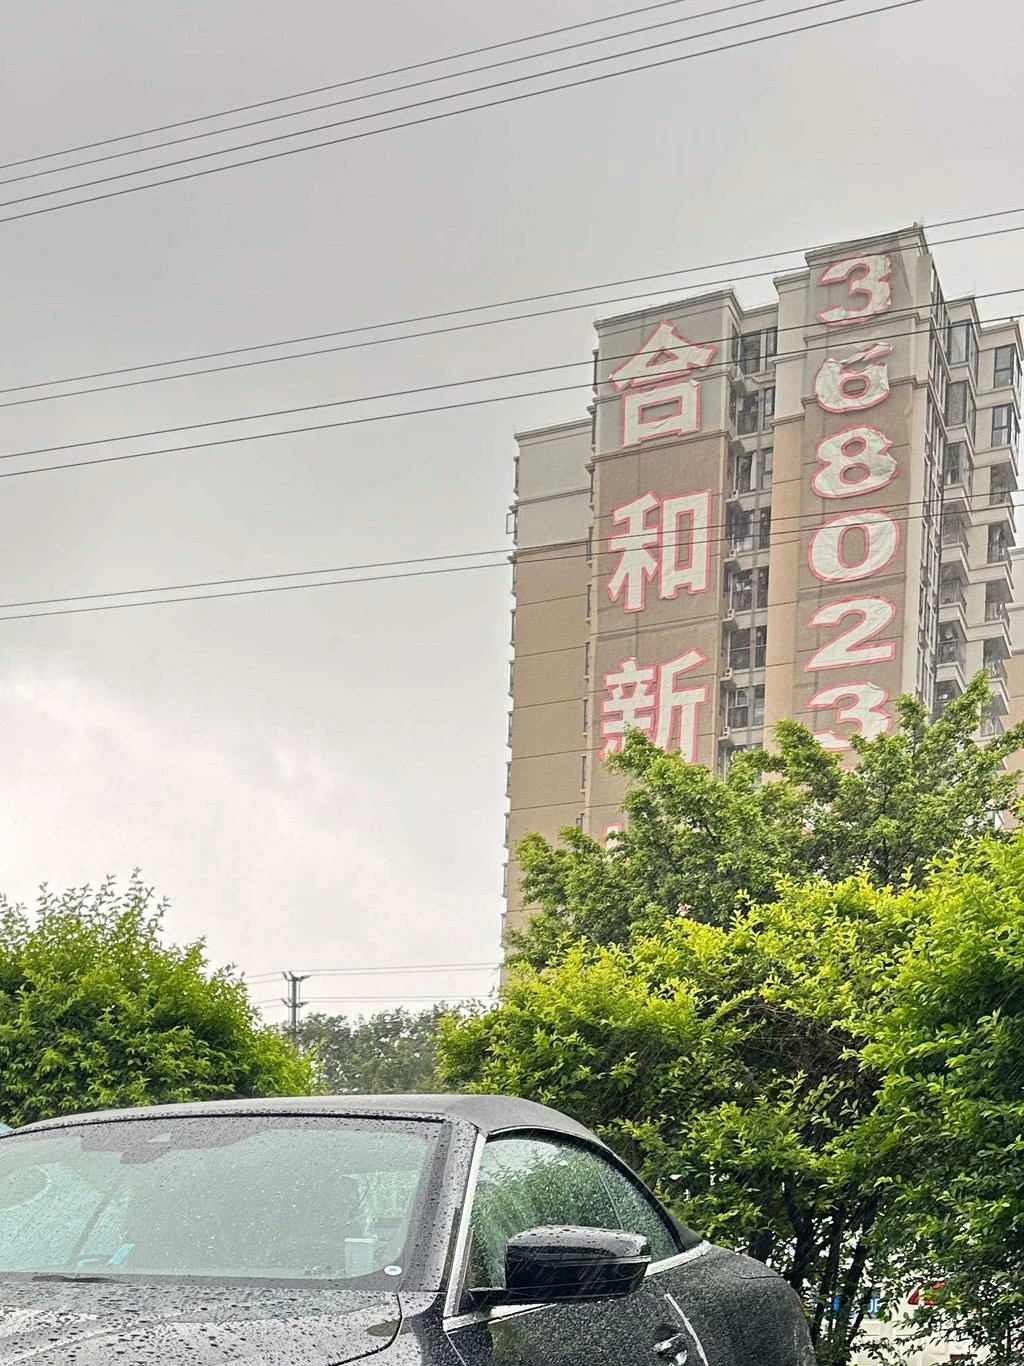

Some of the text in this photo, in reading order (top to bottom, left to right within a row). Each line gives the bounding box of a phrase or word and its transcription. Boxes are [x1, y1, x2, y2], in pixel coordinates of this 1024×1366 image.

[600, 320, 716, 850] 合和新
[807, 252, 900, 770] 368023
